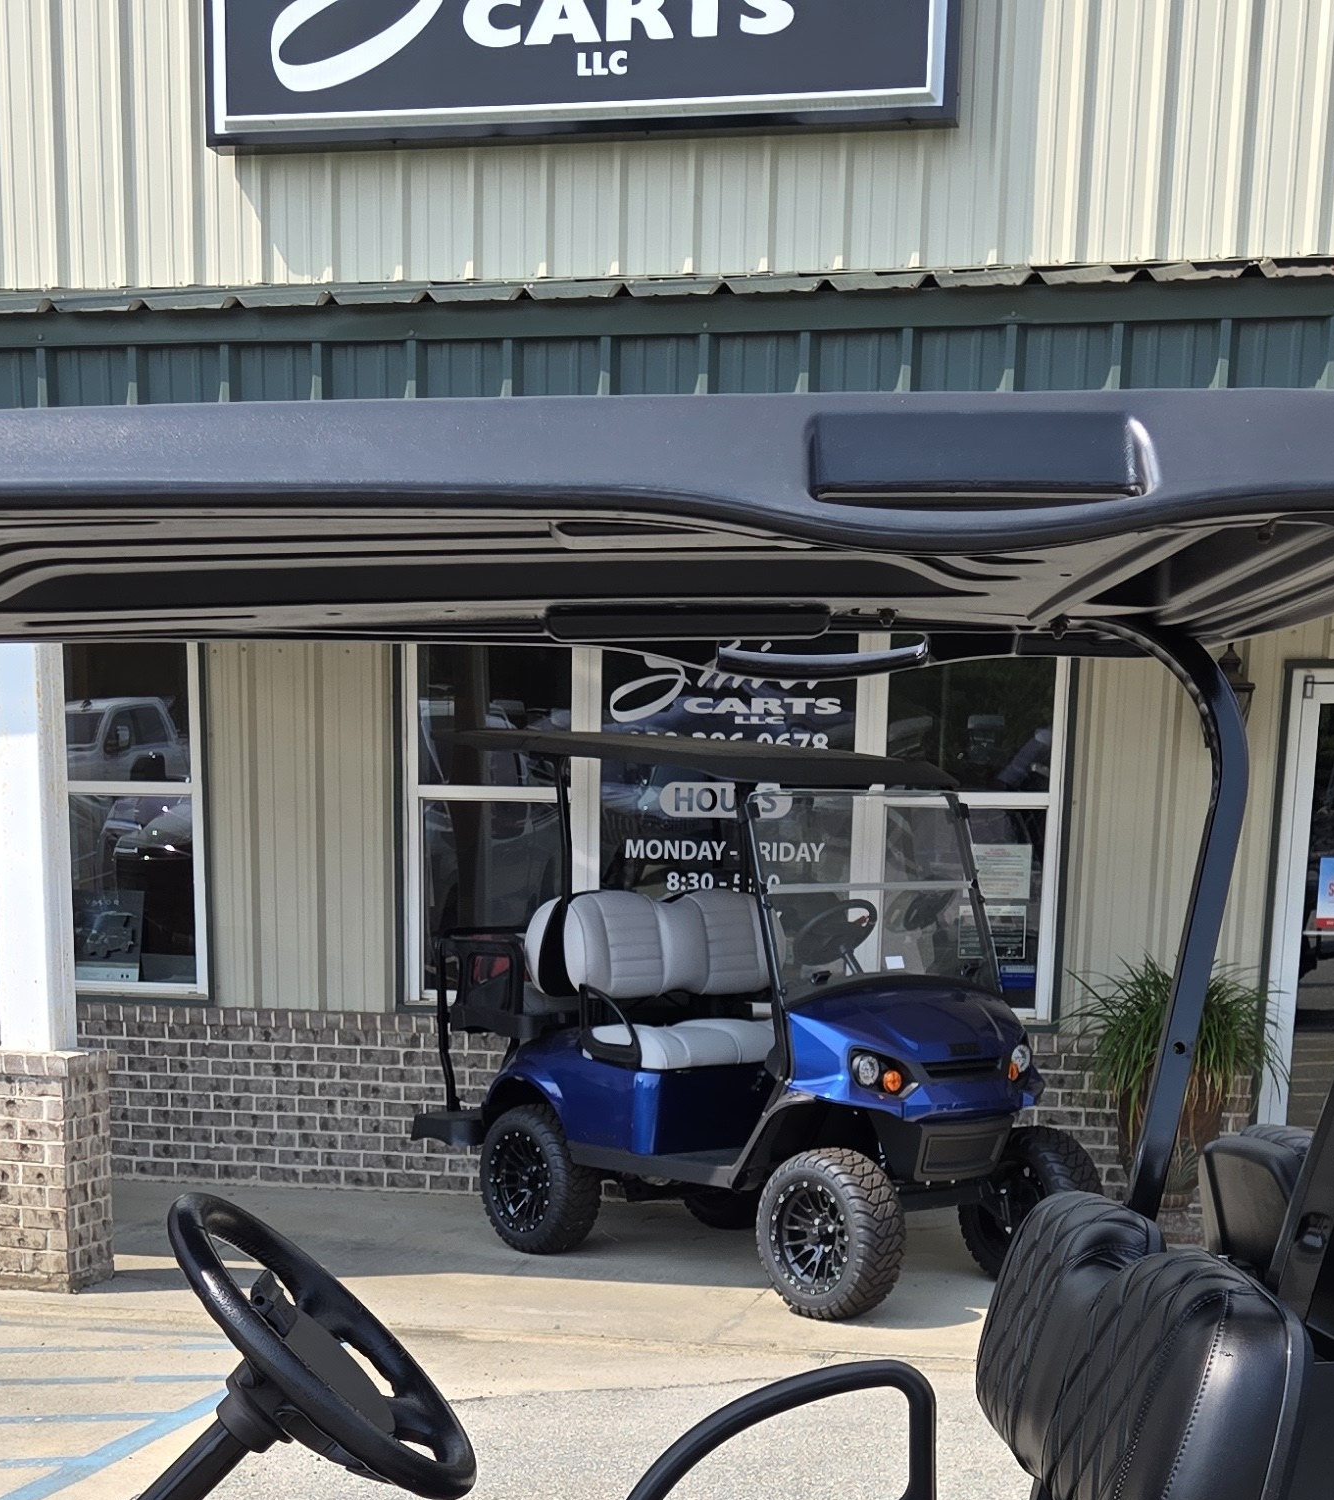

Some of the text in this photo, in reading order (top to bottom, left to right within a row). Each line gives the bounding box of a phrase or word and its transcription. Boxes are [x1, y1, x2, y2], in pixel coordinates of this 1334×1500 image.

[576, 51, 628, 76] LLC
[683, 697, 842, 715] CARTS
[734, 716, 785, 725] LLC
[675, 787, 778, 812] HOUS
[625, 839, 727, 861] MONDAY
[757, 841, 825, 862] RIDAY
[667, 872, 714, 891] 8:30
